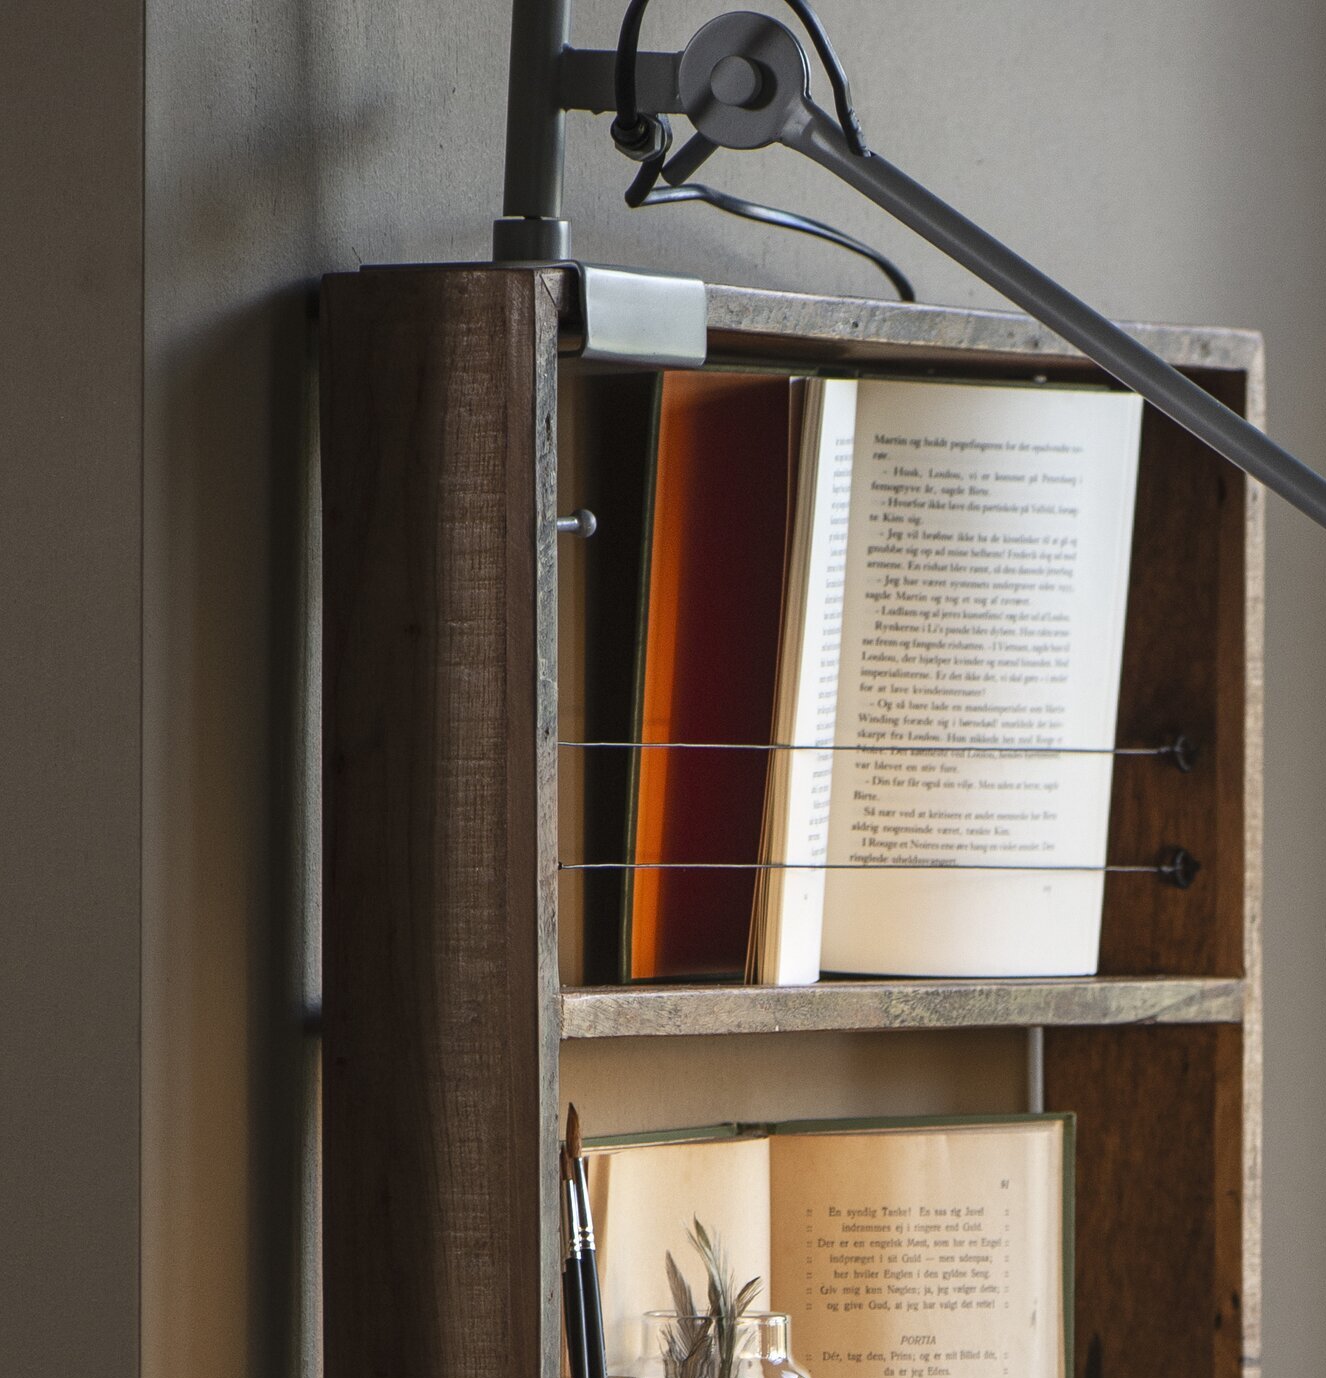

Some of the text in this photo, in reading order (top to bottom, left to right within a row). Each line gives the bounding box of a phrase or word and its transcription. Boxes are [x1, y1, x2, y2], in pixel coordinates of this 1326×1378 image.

[828, 1206, 842, 1217] En
[846, 1207, 877, 1219] syndig
[817, 1238, 836, 1248] Der
[869, 1239, 903, 1249] engelsk
[833, 1270, 849, 1279] her
[820, 1285, 838, 1295] Giv
[842, 1287, 861, 1296] mig
[865, 1286, 883, 1294] kun
[826, 1303, 840, 1312] og
[843, 1302, 864, 1312] give
[900, 1335, 937, 1345] PORTIA
[847, 1352, 862, 1363] tag
[898, 1368, 908, 1376] er
[911, 1368, 924, 1378] jeg
